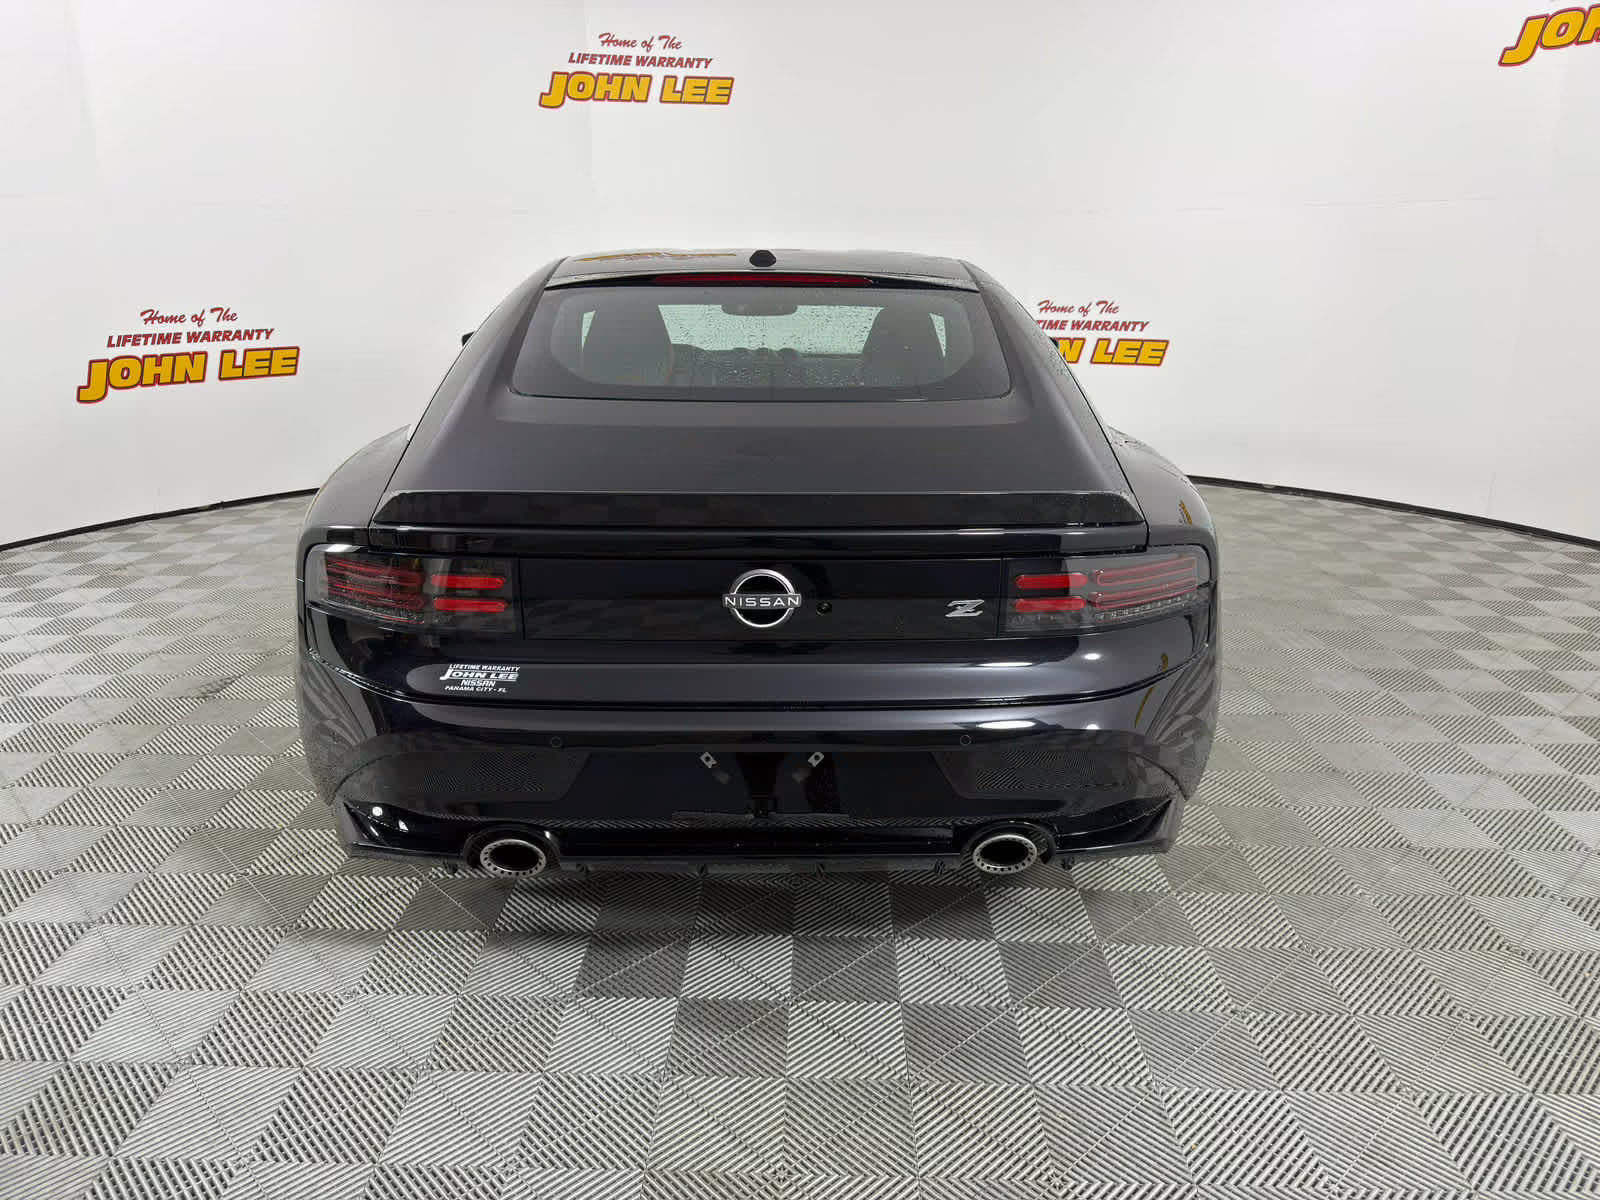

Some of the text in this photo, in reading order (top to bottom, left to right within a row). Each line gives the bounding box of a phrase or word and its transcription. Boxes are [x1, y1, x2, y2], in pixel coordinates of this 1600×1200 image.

[598, 32, 682, 53] Home of The
[568, 52, 713, 69] LIFETIME WARRANTY
[539, 71, 735, 109] JOHN LEE
[140, 307, 238, 328] Home of The
[1037, 299, 1120, 317] Home of The
[1036, 319, 1149, 332] TIME WARRANTY
[106, 328, 275, 348] LIFETIME WARRANTY
[1090, 338, 1169, 366] LEE
[76, 346, 300, 404] JOHN LEE
[724, 595, 800, 607] NISSAN
[945, 599, 985, 618] Z
[440, 669, 520, 681] JOHN LEE
